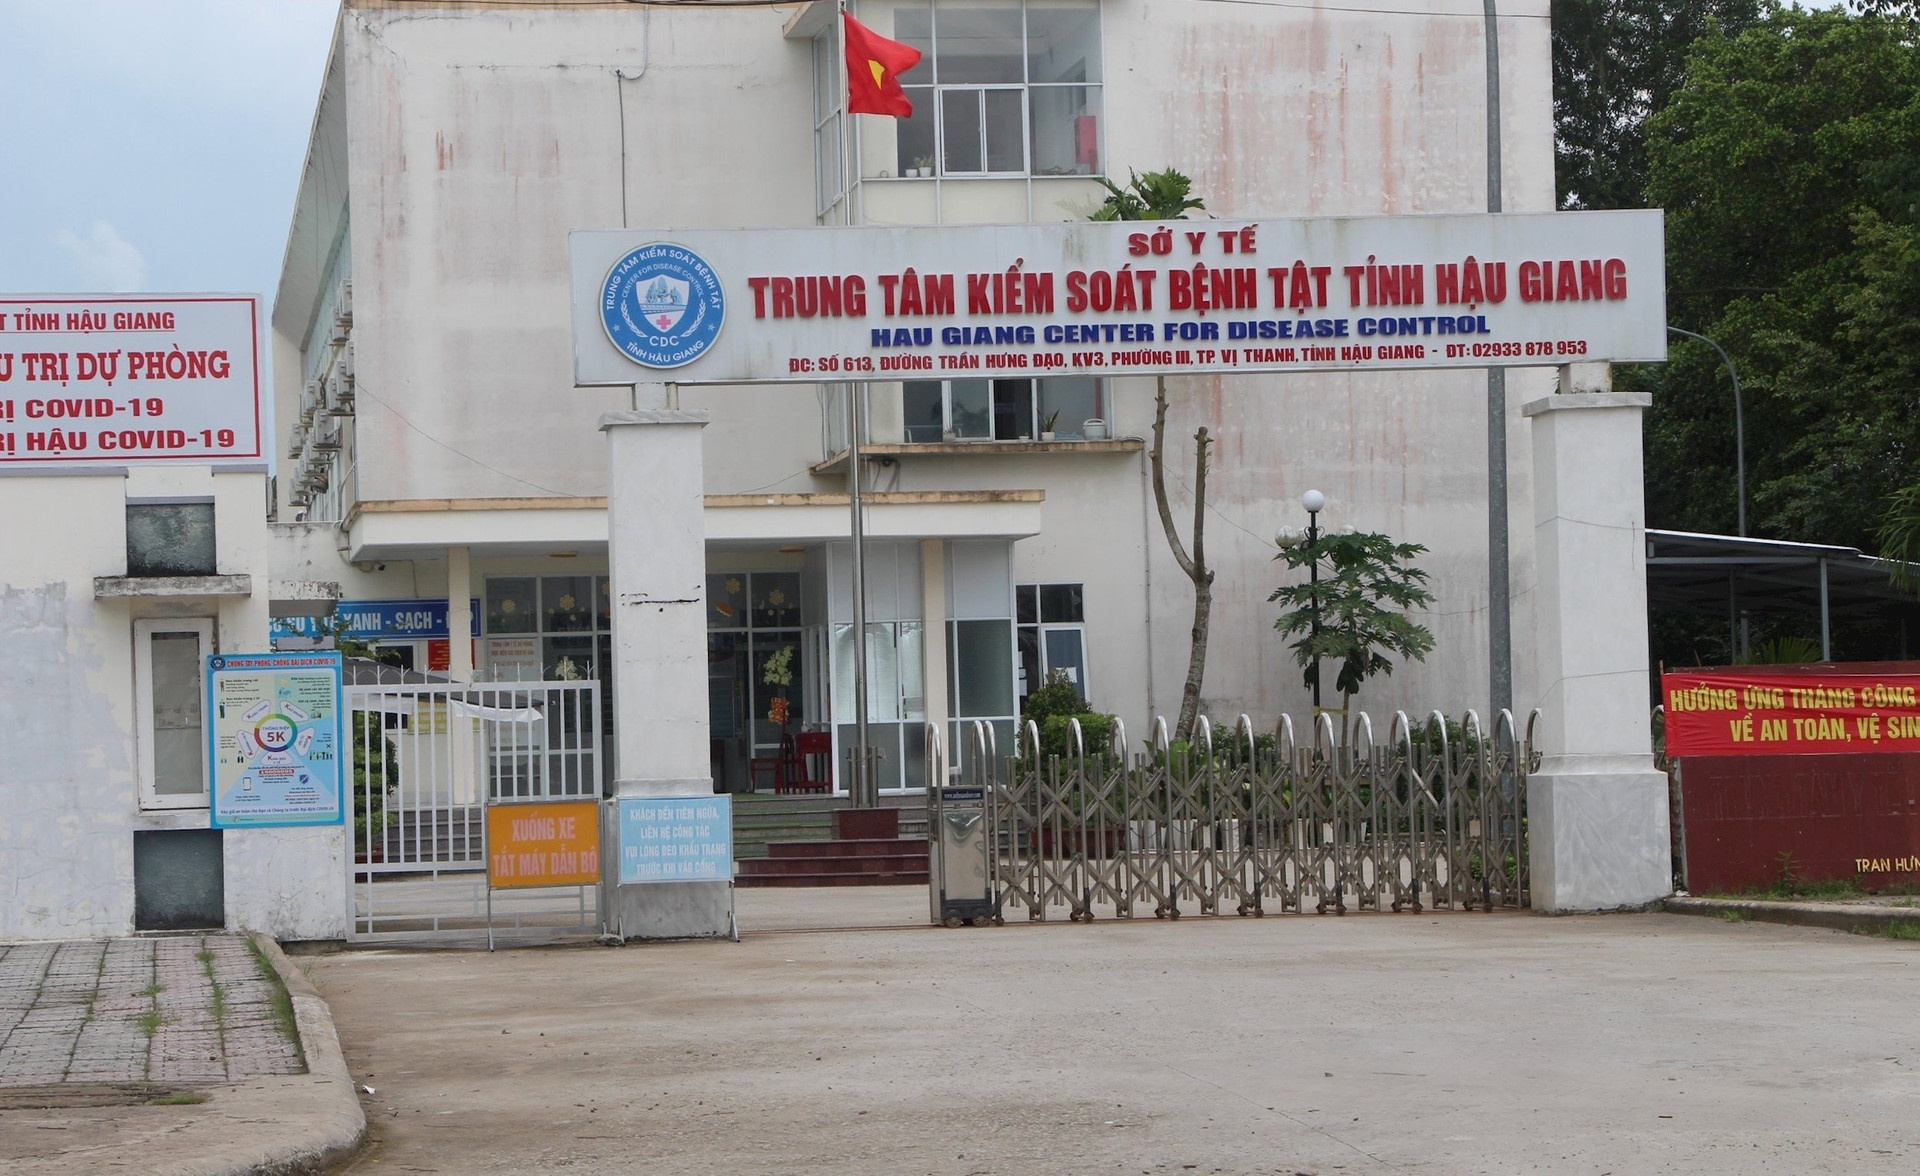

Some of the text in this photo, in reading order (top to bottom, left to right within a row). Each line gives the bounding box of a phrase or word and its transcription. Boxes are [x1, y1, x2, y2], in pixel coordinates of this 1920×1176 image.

[1129, 223, 1259, 256] SỞ Y TẾ
[607, 245, 721, 310] TRUNG TÂM KIỂM SOÁT BỆNH TẬT
[621, 262, 705, 298] CENTER FOR DISEASE CONTROL
[748, 254, 1628, 319] TRUNG TÂM KIỂM SOÁT BỆNH TẬT TỈNH HẬU GIANG
[13, 308, 60, 331] TỈNH
[66, 309, 107, 334] HẬU
[113, 312, 175, 330] GIANG
[871, 315, 1491, 347] HAU GIANG CENTER FOR DISEASE CONTROL
[626, 340, 704, 364] TỈNH HẬU GIANG
[649, 335, 680, 347] CDC
[22, 353, 69, 388] TRỊ
[76, 349, 122, 387] DỰ
[127, 343, 231, 380] PHÒNG
[789, 358, 815, 373] ĐC:
[818, 353, 839, 372] SỐ
[843, 357, 876, 373] 613,
[879, 353, 933, 371] ĐƯỜNG
[938, 351, 980, 370] TRẦN
[986, 353, 1028, 369] HƯNG
[1032, 352, 1068, 371] ĐẠO,
[1072, 352, 1109, 368] KV3,
[1112, 347, 1172, 367] PHƯỜNG
[1175, 350, 1194, 366] III,
[1221, 349, 1238, 367] VỊ
[1243, 348, 1299, 364] THANH,
[1301, 344, 1336, 362] TỈNH
[1341, 343, 1372, 363] HẬU
[1378, 345, 1425, 360] GIANG
[1525, 341, 1554, 356] 878
[1556, 340, 1588, 355] 953
[25, 398, 164, 418] COVID-19
[26, 427, 87, 455] HẬU
[98, 429, 235, 450] COVID-19
[346, 612, 382, 632] XANH
[395, 611, 433, 634] SẠCH
[1670, 681, 1917, 711] HƯỞNG ỨNG THÁNG CÔNG
[267, 732, 286, 742] 5K
[1730, 712, 1754, 742] VỀ
[1760, 719, 1788, 741] AN
[1793, 714, 1852, 742] TOÀN,
[1856, 712, 1881, 744] VỆ
[511, 811, 576, 841] XUỐNG XE
[640, 824, 659, 839] LIÊN
[695, 823, 710, 837] TÁC
[493, 845, 515, 877] TẮT
[519, 848, 547, 876] MÁY
[580, 845, 598, 879] BỘ
[625, 846, 638, 858] VUI
[701, 843, 726, 855] TRANG
[1855, 858, 1891, 872] TRAN
[663, 862, 676, 874] KHI
